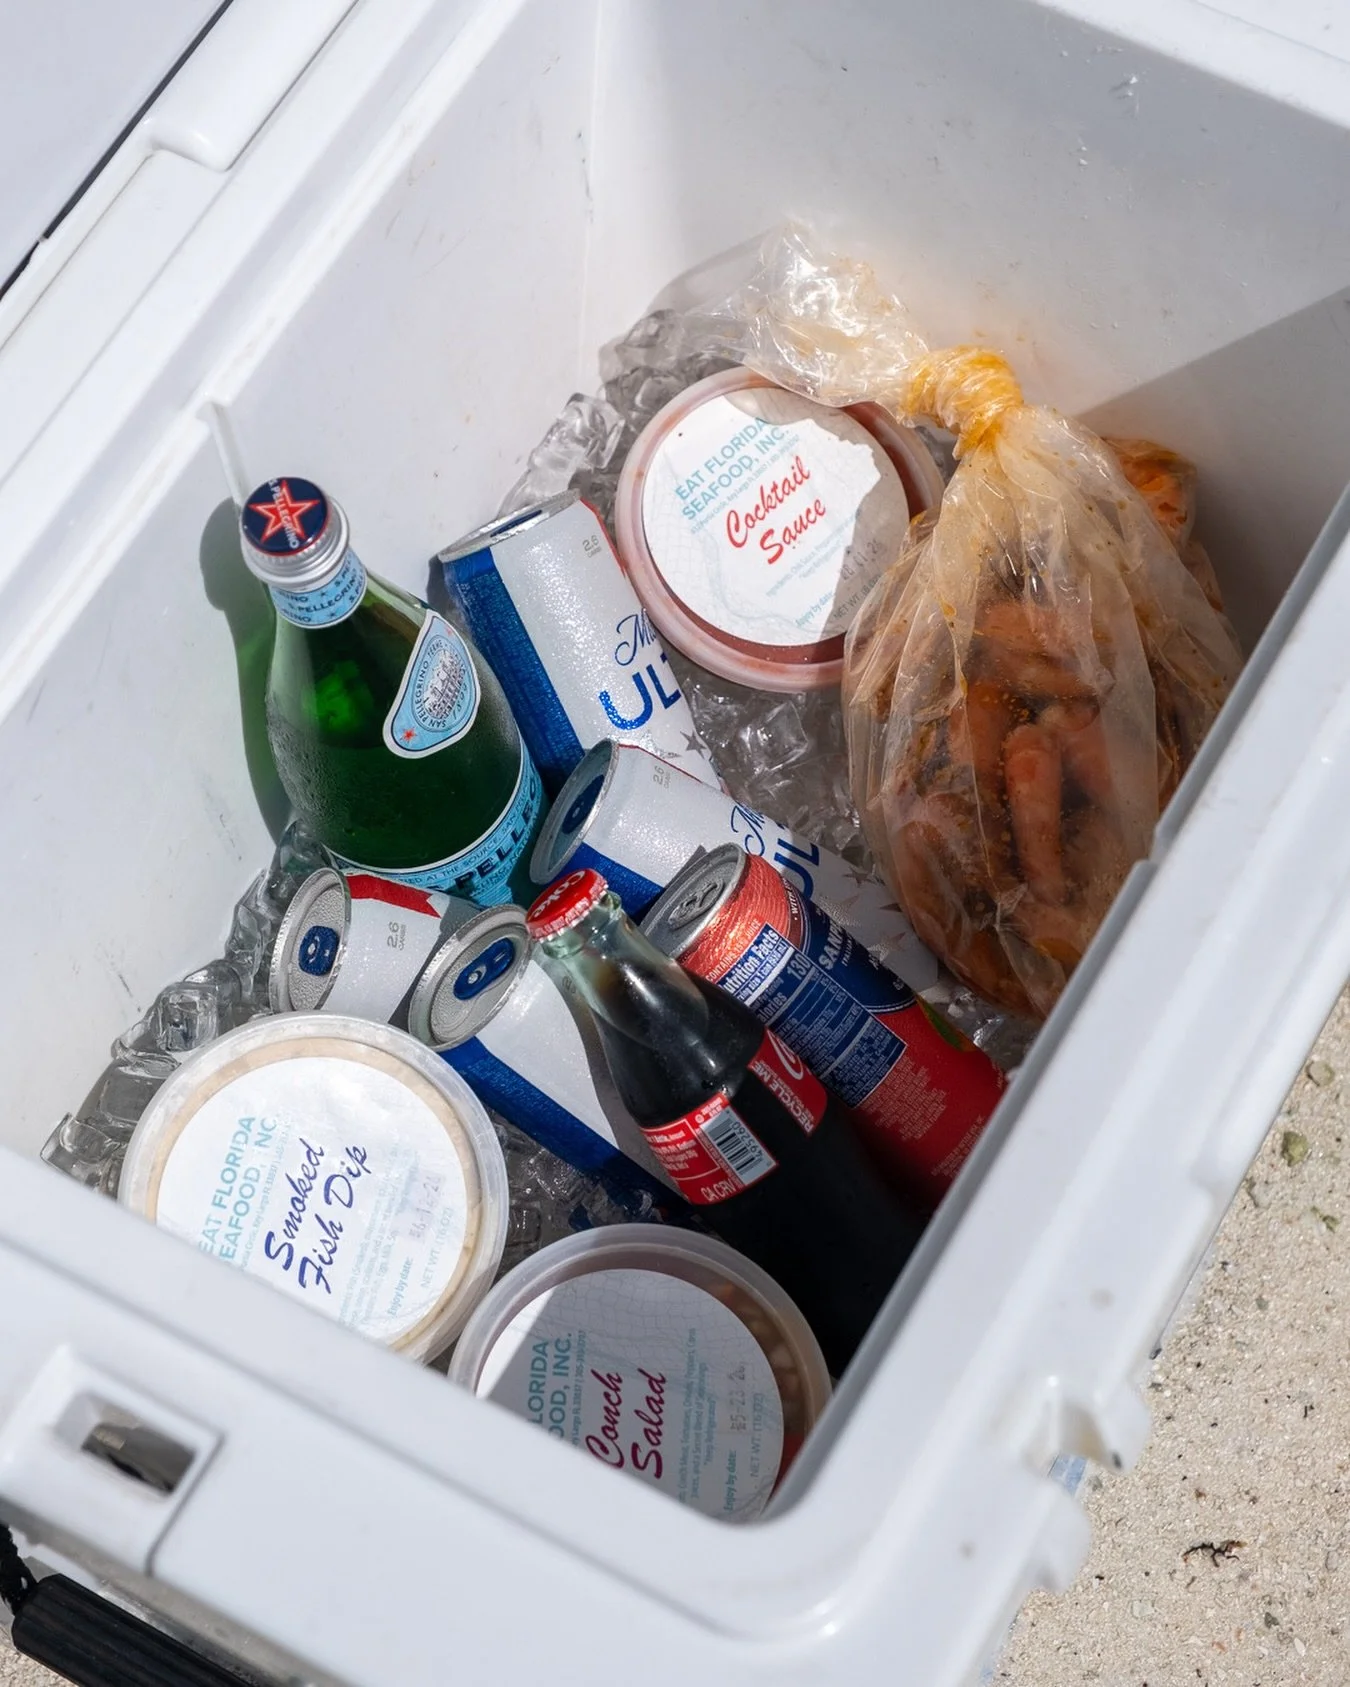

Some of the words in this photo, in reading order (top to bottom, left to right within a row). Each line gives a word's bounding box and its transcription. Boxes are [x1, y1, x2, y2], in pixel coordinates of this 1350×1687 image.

[675, 471, 706, 501] EAT
[704, 417, 771, 475] FLORIDA
[682, 454, 760, 521] SEAFOOD,
[755, 428, 790, 455] INC.
[726, 455, 811, 548] Cocktail
[759, 497, 826, 565] Sauce
[582, 534, 600, 552] 2.6
[598, 652, 683, 731] UL
[652, 765, 665, 787] 2.6
[440, 864, 463, 877] THE
[774, 823, 821, 901] UL
[386, 921, 400, 949] 2.6
[705, 950, 737, 984] CONTAINS
[744, 917, 762, 939] JUICE
[718, 953, 762, 994] utrition
[750, 927, 780, 960] Facts
[755, 990, 788, 1023] alories
[784, 952, 812, 981] 130
[750, 1061, 772, 1083] ME
[768, 1079, 815, 1133] RECYCLE
[199, 1213, 222, 1253] EAT
[212, 1115, 256, 1210] FLORIDA
[264, 1138, 325, 1271] Smoked
[700, 1185, 715, 1202] CA
[714, 1179, 736, 1200] CRV
[219, 1162, 266, 1268] EAFOOD,
[297, 1213, 344, 1294] Fish
[323, 1143, 373, 1209] Dip
[386, 1290, 405, 1317] Enjoy
[394, 1278, 409, 1293] by
[418, 1264, 436, 1289] NET
[528, 1341, 551, 1426] LORIDA
[552, 1332, 573, 1378] INC.
[549, 1384, 571, 1439] OOD,
[585, 1368, 625, 1469] Conch
[631, 1367, 667, 1480] Salad
[726, 1449, 738, 1473] date:
[726, 1473, 737, 1486] by
[750, 1458, 760, 1477] NET
[723, 1486, 735, 1513] Enjoy
